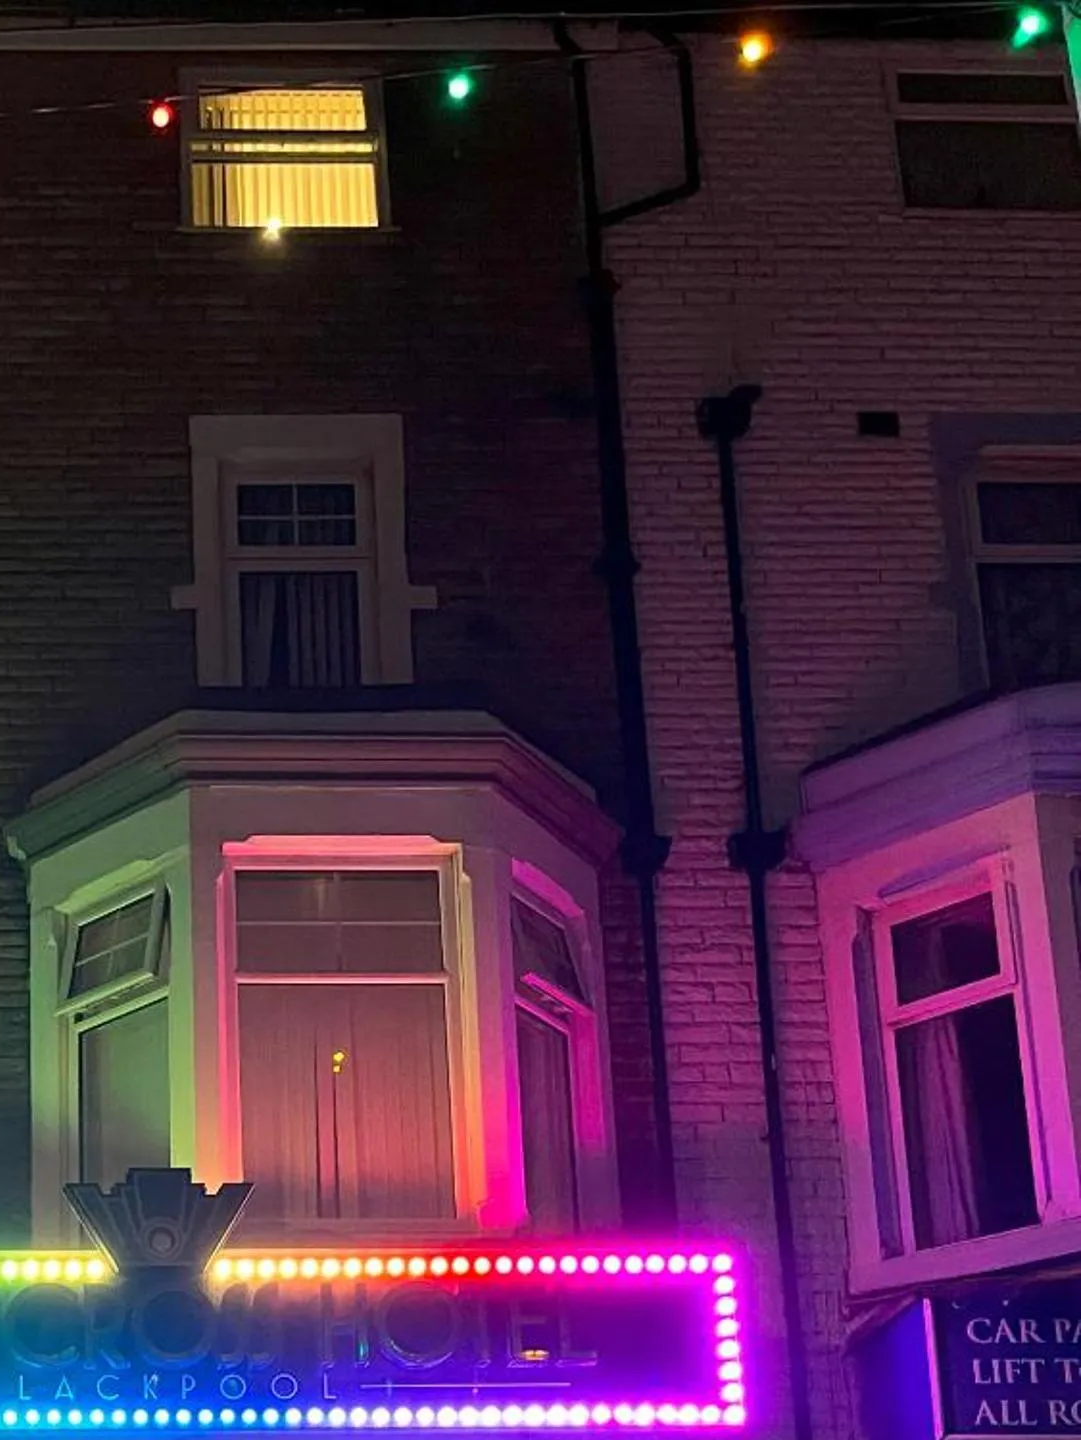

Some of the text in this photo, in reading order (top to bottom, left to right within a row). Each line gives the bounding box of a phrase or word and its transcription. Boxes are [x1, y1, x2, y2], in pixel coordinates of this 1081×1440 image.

[321, 1281, 598, 1369] HOTEL
[966, 1317, 1046, 1344] CAR
[972, 1358, 1081, 1384] LIFT T
[975, 1399, 1038, 1426] ALL
